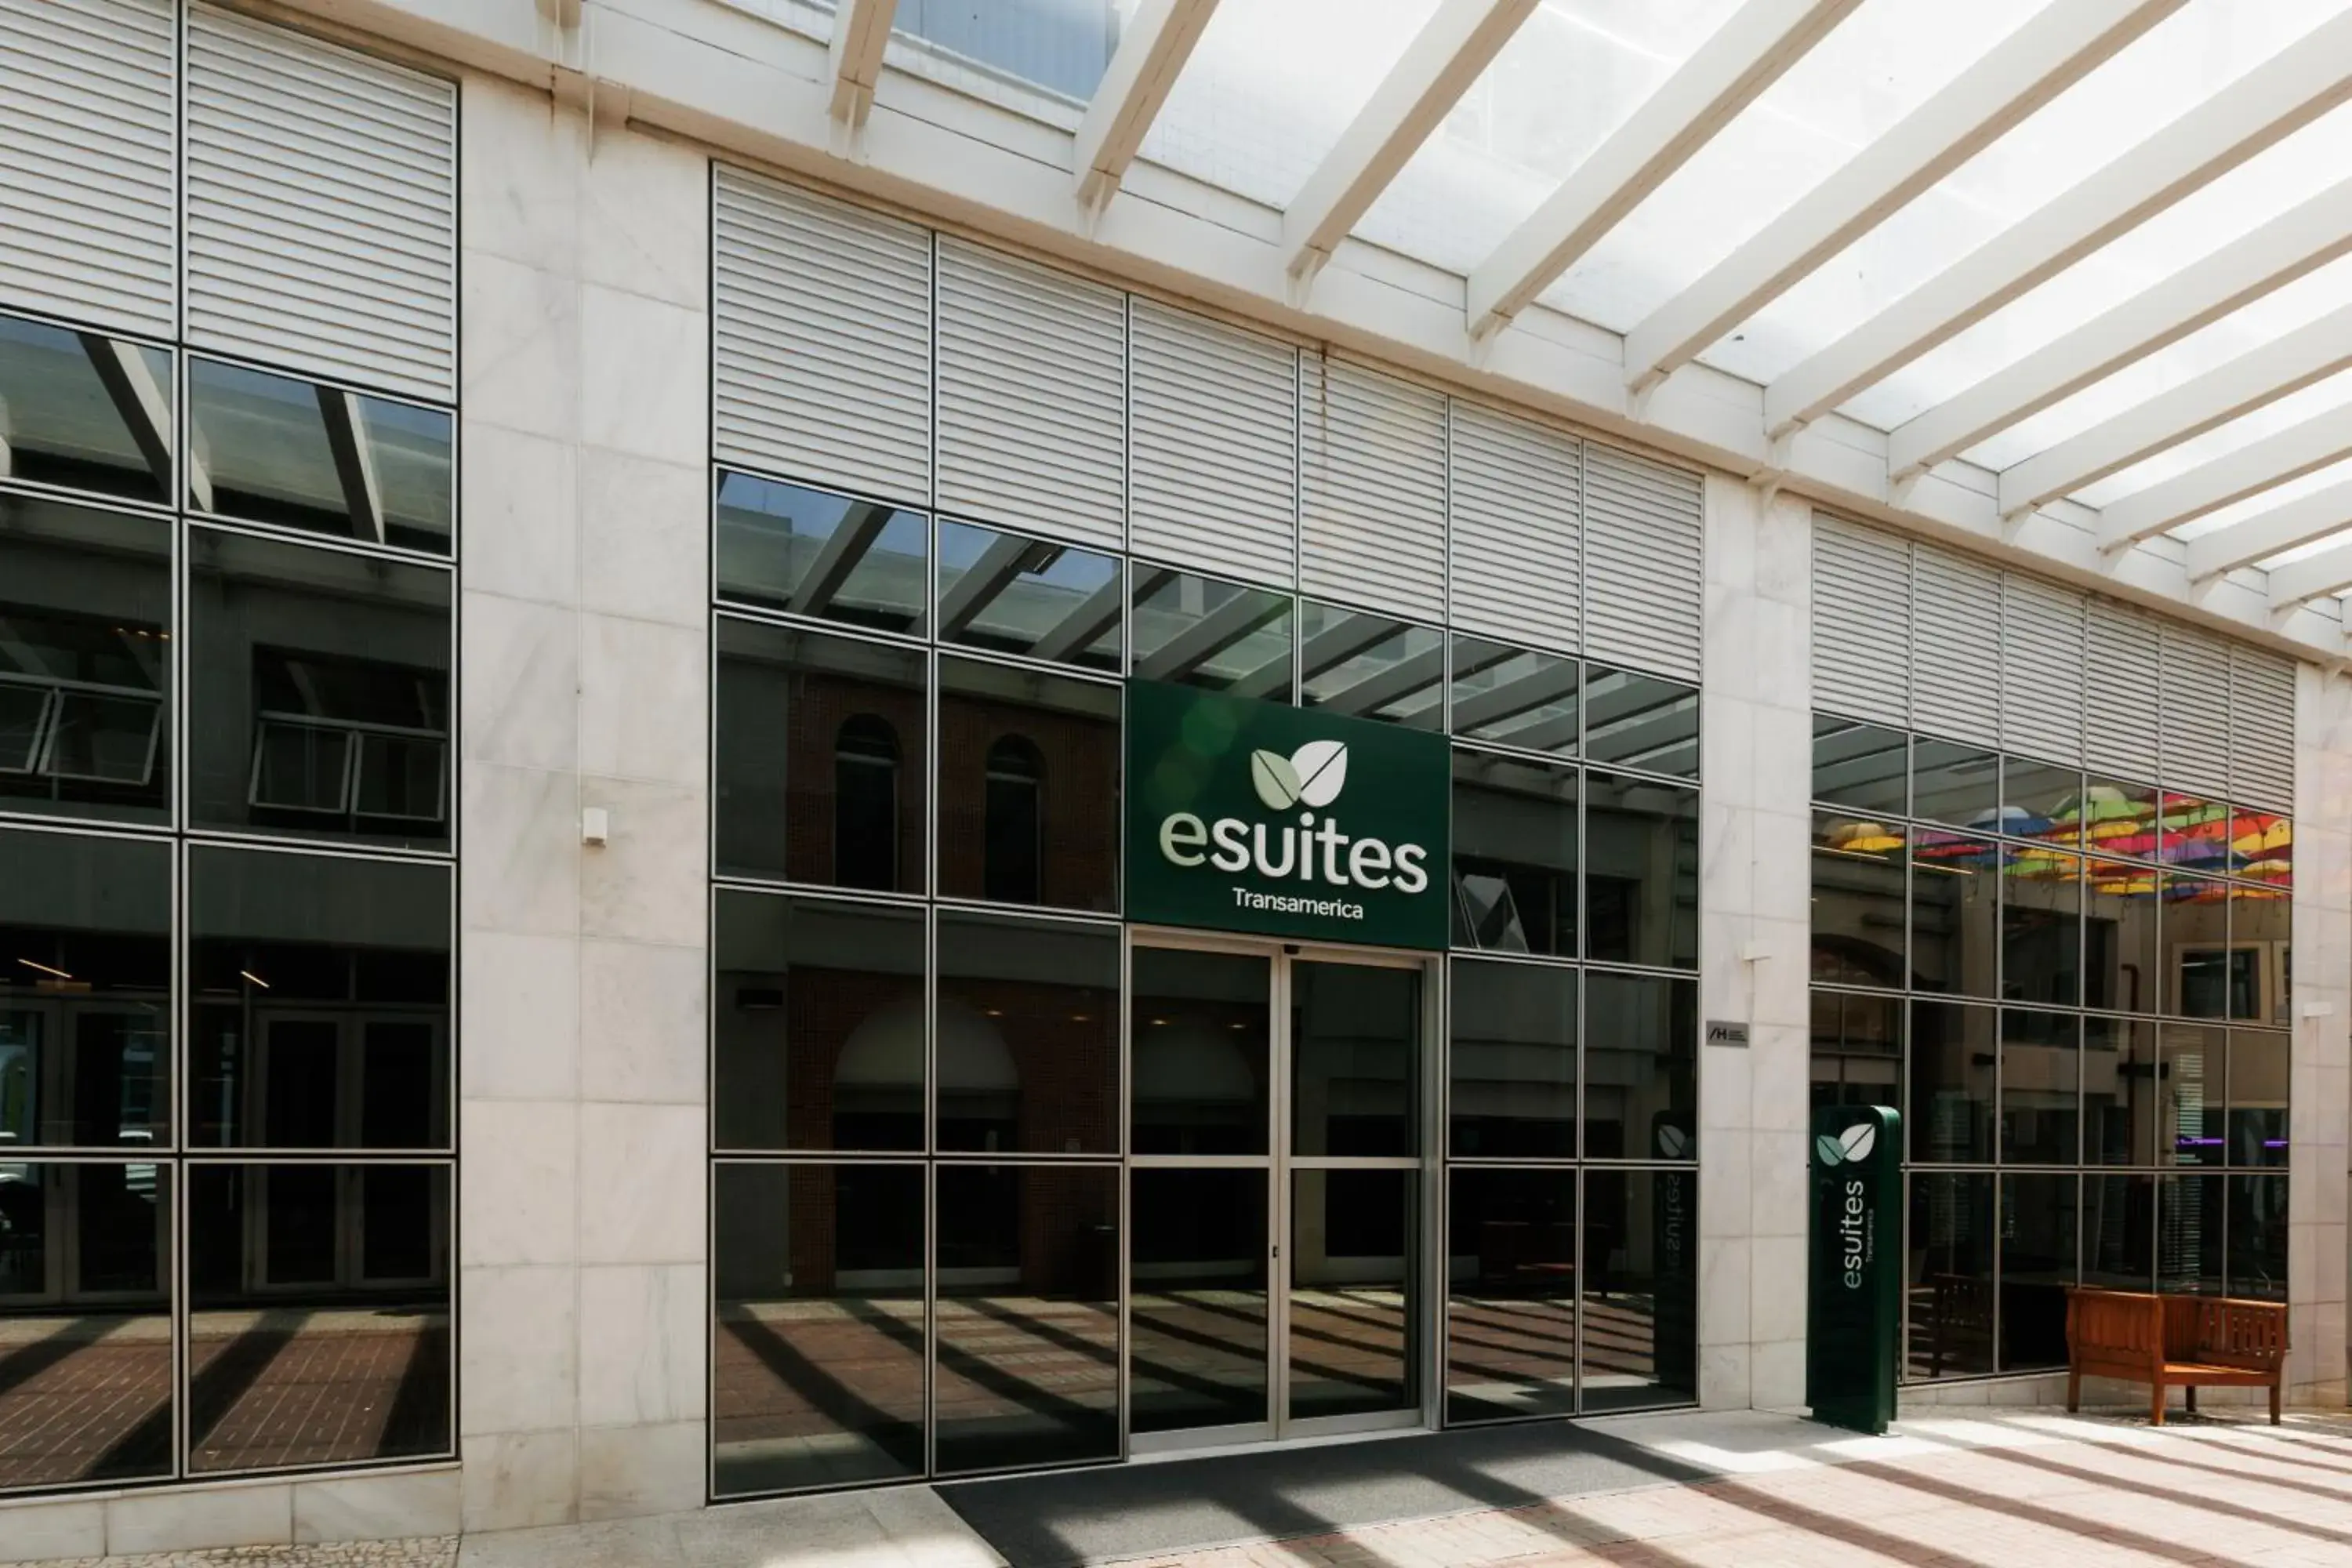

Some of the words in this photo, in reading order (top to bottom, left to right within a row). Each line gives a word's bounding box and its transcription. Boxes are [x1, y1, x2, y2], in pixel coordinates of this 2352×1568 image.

[1159, 811, 1428, 894] esuites
[1232, 887, 1363, 920] Transamerica
[1839, 1180, 1864, 1289] esuites
